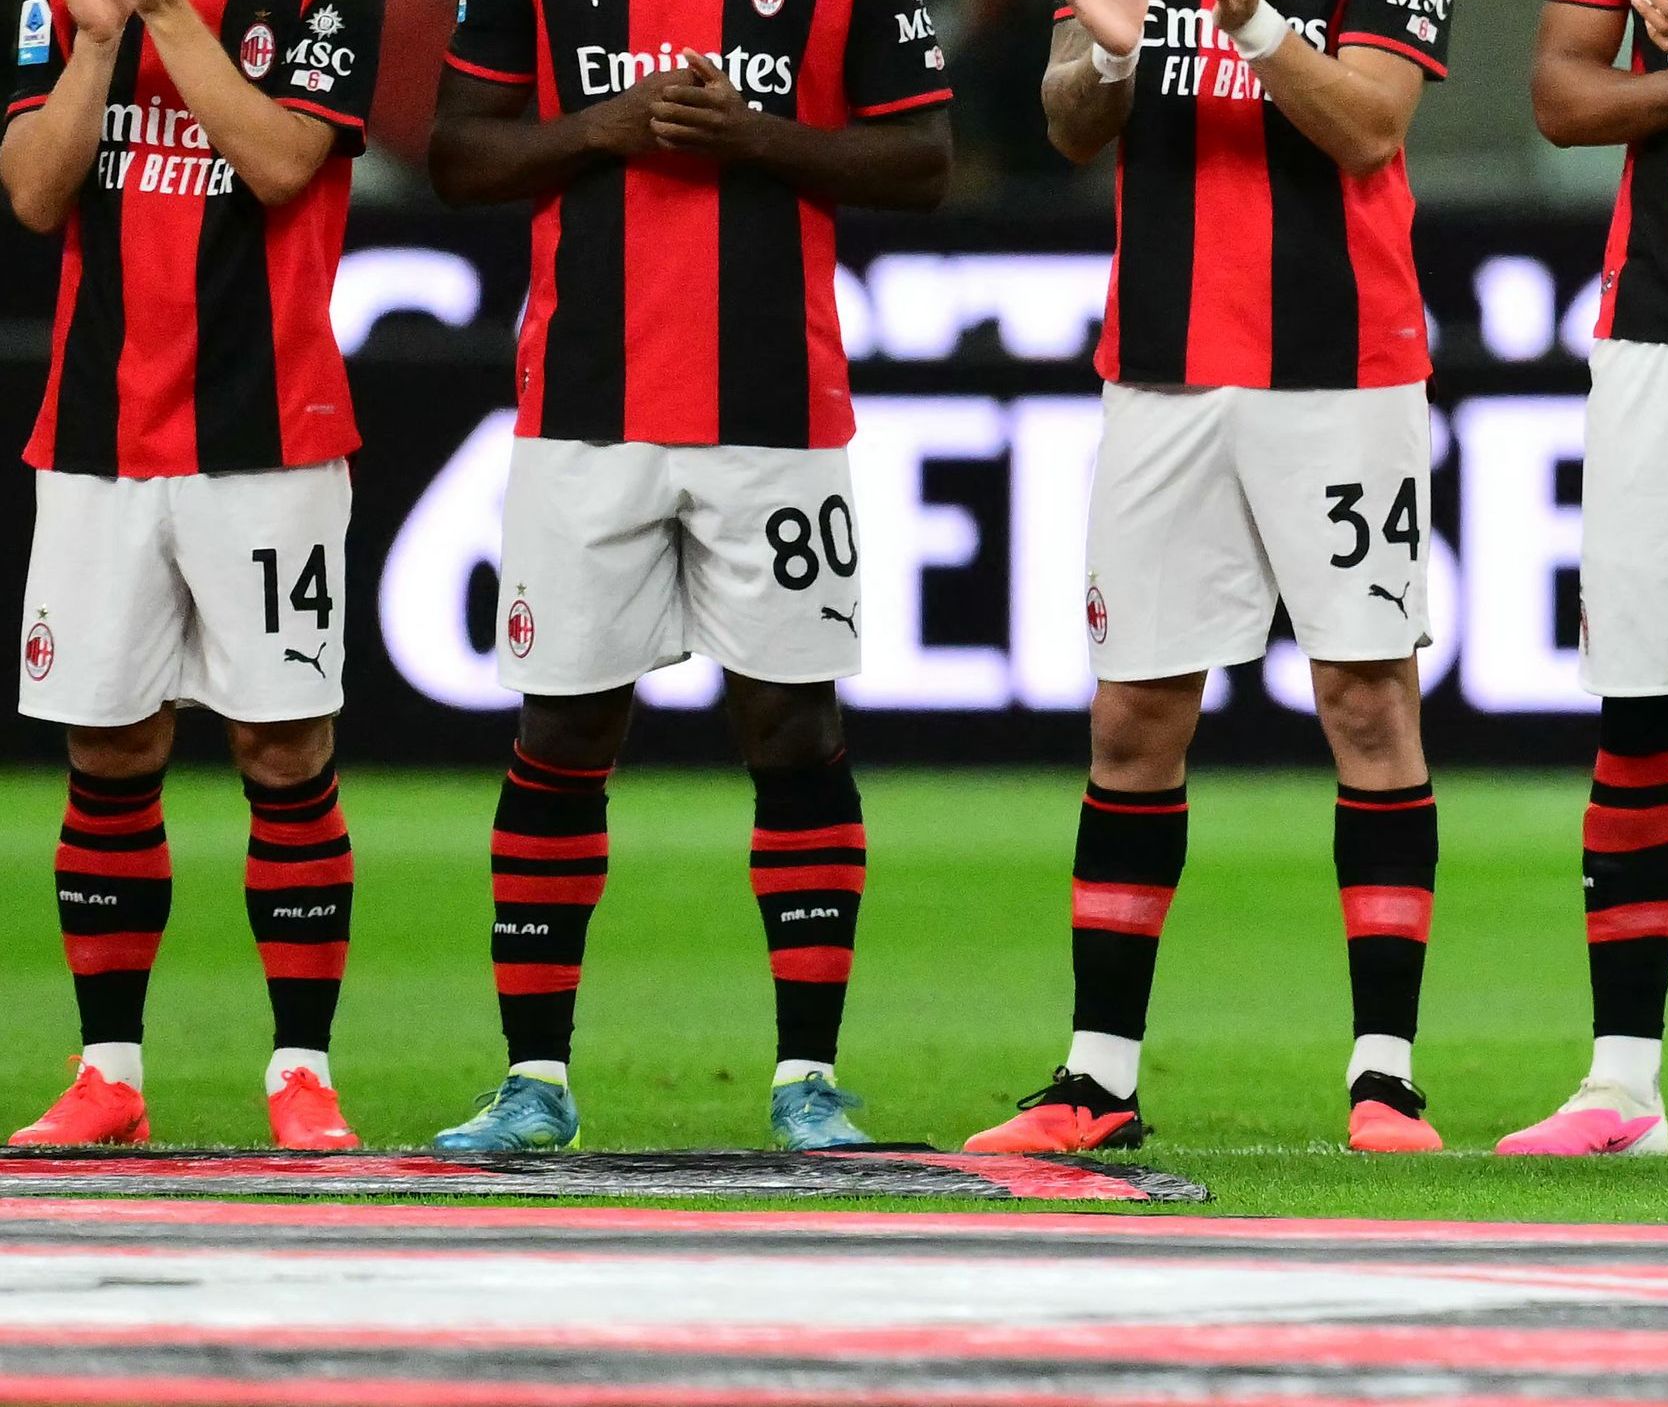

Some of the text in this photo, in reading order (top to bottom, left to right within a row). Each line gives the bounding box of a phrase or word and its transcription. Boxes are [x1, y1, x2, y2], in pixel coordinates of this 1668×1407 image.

[281, 38, 356, 77] MSC
[1160, 55, 1208, 96] FLY
[101, 95, 211, 150] mira
[98, 151, 235, 197] FLY BETTER
[765, 494, 859, 591] 80
[1325, 477, 1420, 569] 34
[251, 543, 333, 634] 14
